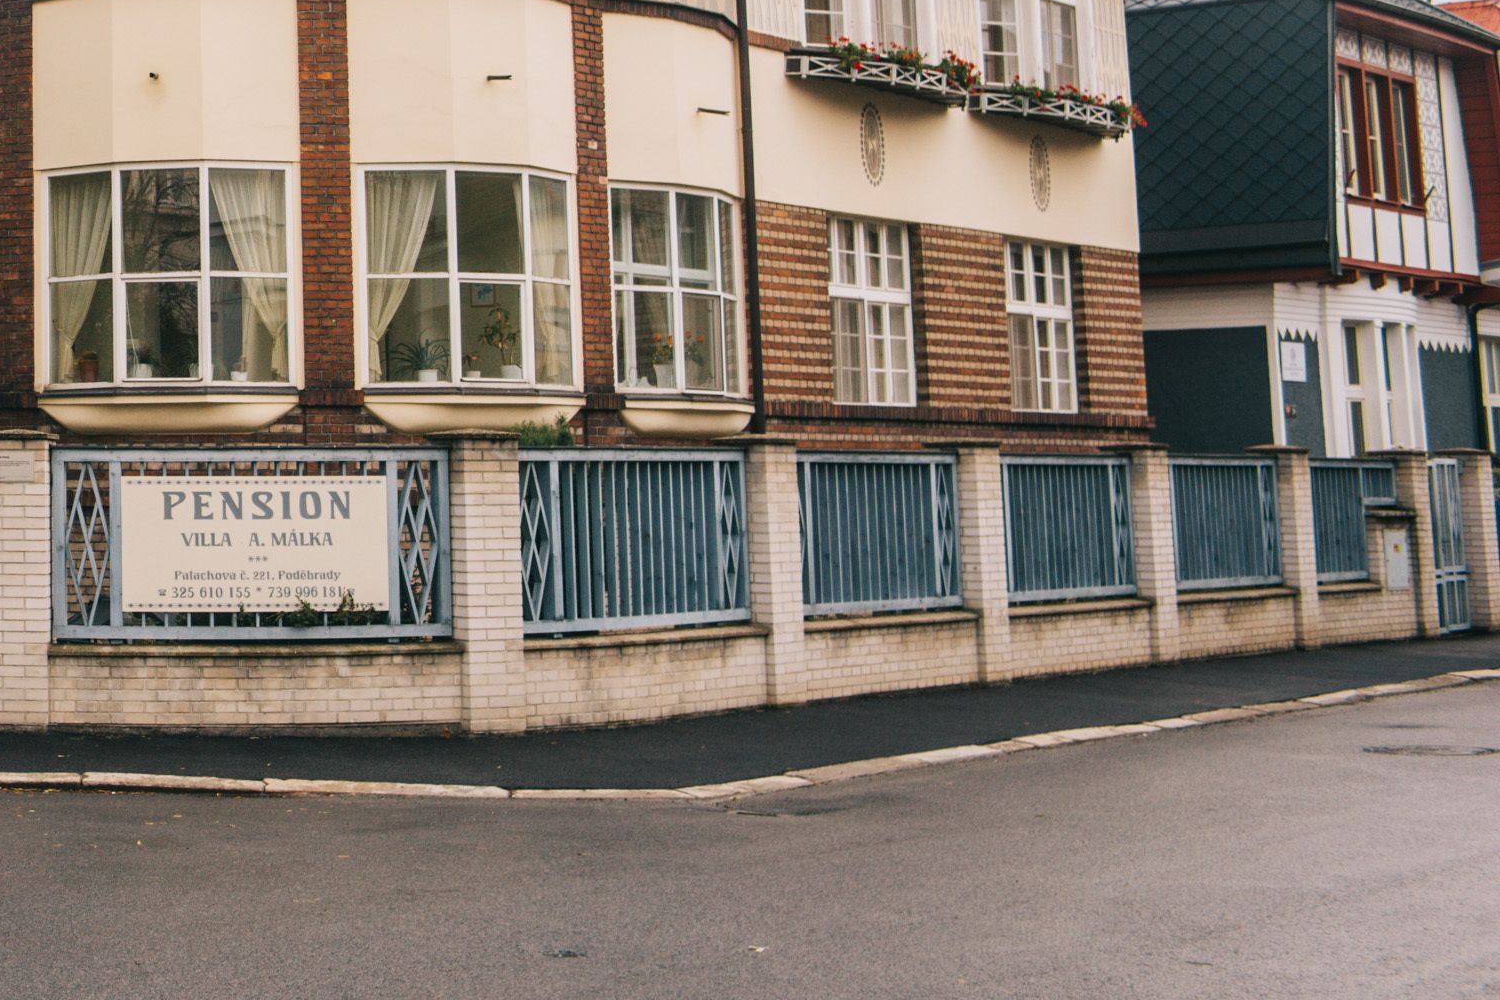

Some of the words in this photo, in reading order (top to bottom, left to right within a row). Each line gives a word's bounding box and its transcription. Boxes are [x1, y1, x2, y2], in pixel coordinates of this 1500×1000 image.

[161, 490, 351, 520] PENSION
[180, 532, 232, 547] VILLA
[249, 532, 266, 547] A.
[270, 528, 334, 547] MÁLKA
[174, 570, 236, 581] Palachova
[277, 569, 341, 583] Poděbrady
[171, 586, 195, 599] 325
[199, 586, 223, 599] 610
[228, 586, 251, 599] 155
[267, 586, 292, 599] 739
[294, 586, 319, 598] 996
[322, 586, 343, 598] 181
